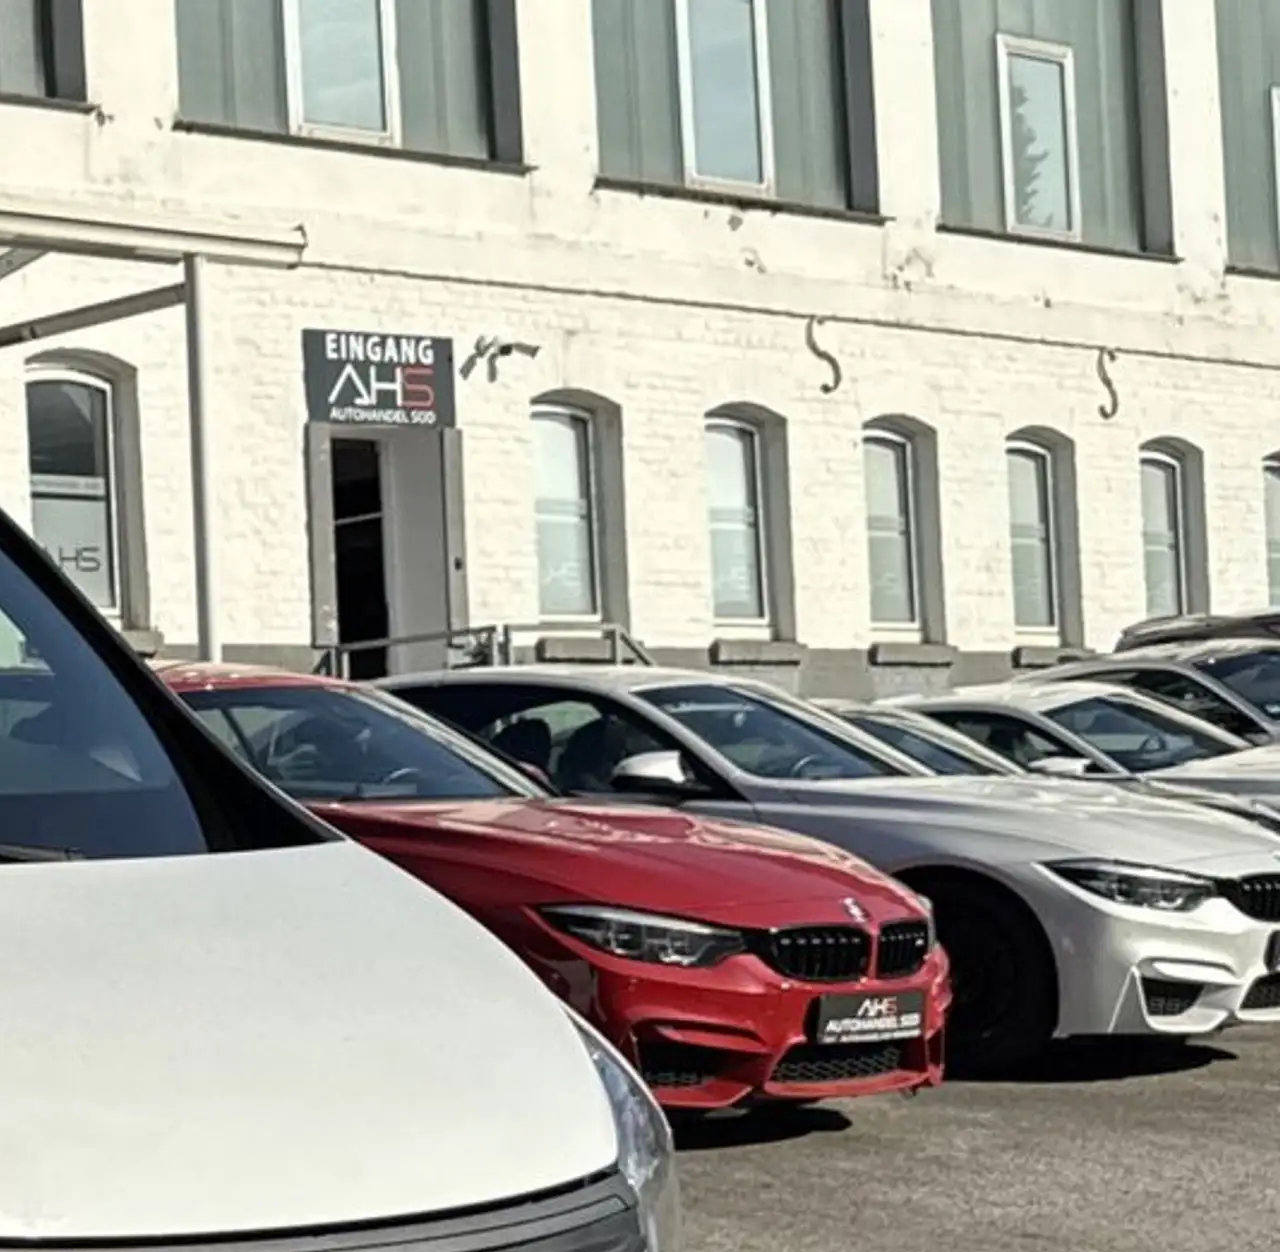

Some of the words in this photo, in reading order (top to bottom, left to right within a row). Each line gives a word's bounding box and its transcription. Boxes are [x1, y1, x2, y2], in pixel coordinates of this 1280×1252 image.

[325, 333, 434, 365] EINGANG
[328, 363, 434, 408] AHS
[329, 406, 409, 424] AUTOHANDEL
